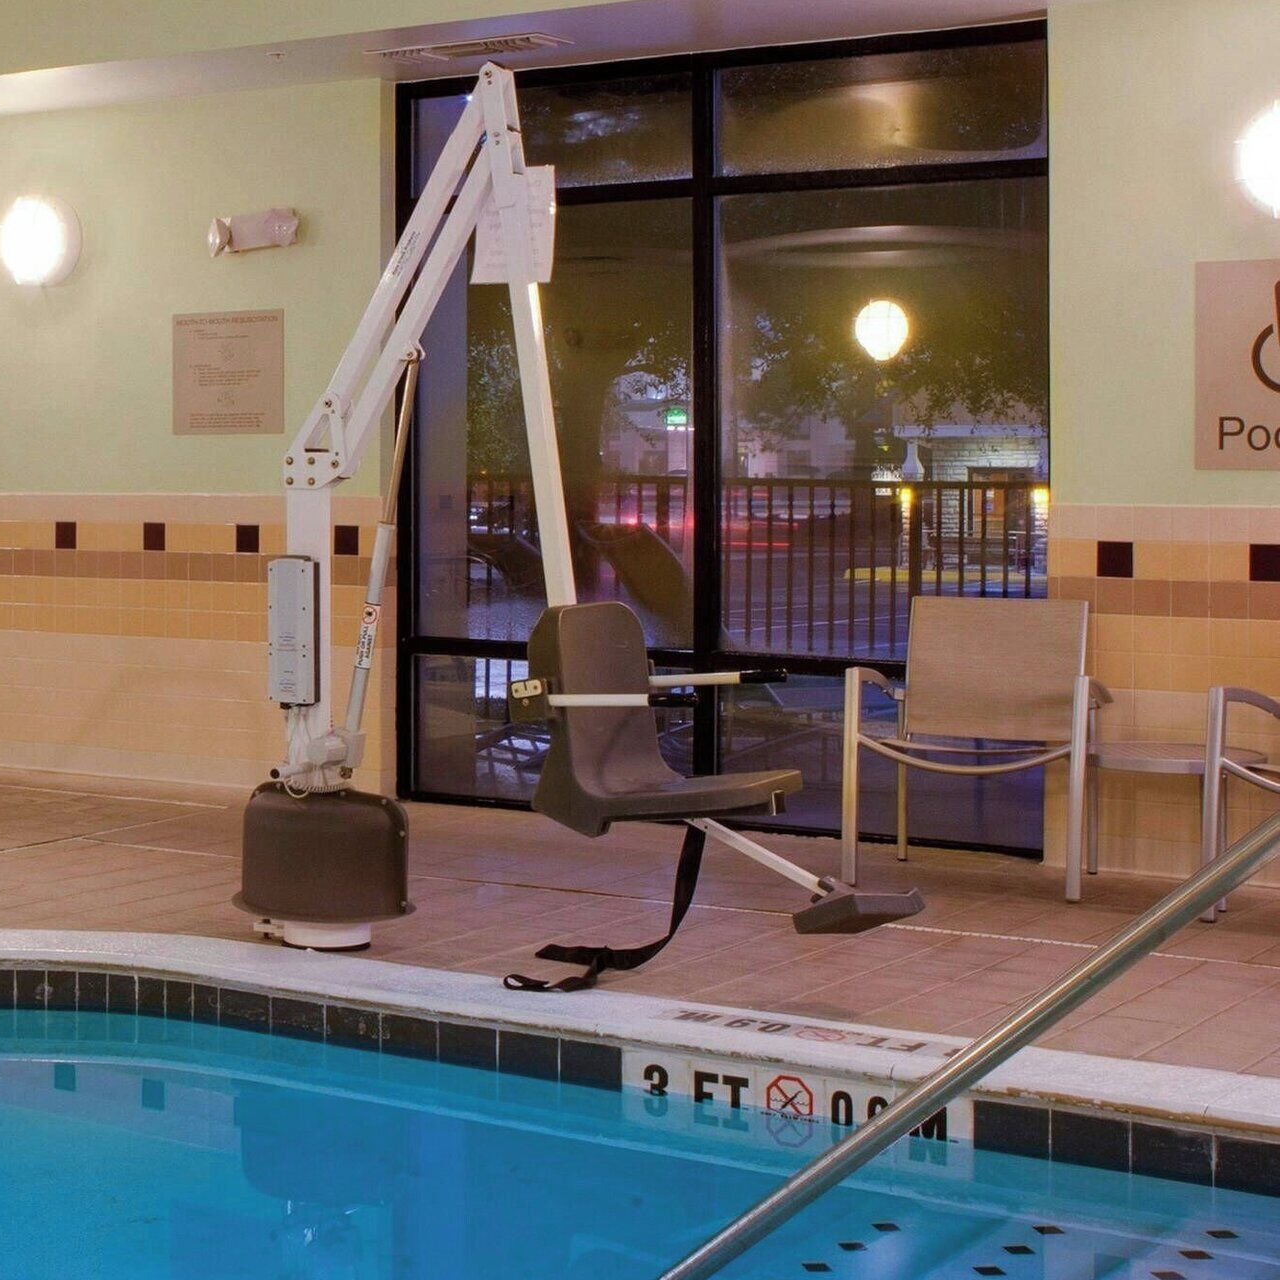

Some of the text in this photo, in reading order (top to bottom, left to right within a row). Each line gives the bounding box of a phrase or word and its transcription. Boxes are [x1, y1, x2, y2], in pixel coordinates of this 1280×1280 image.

[1218, 415, 1280, 452] Po
[643, 1063, 669, 1097] 3
[694, 1070, 749, 1109] FT
